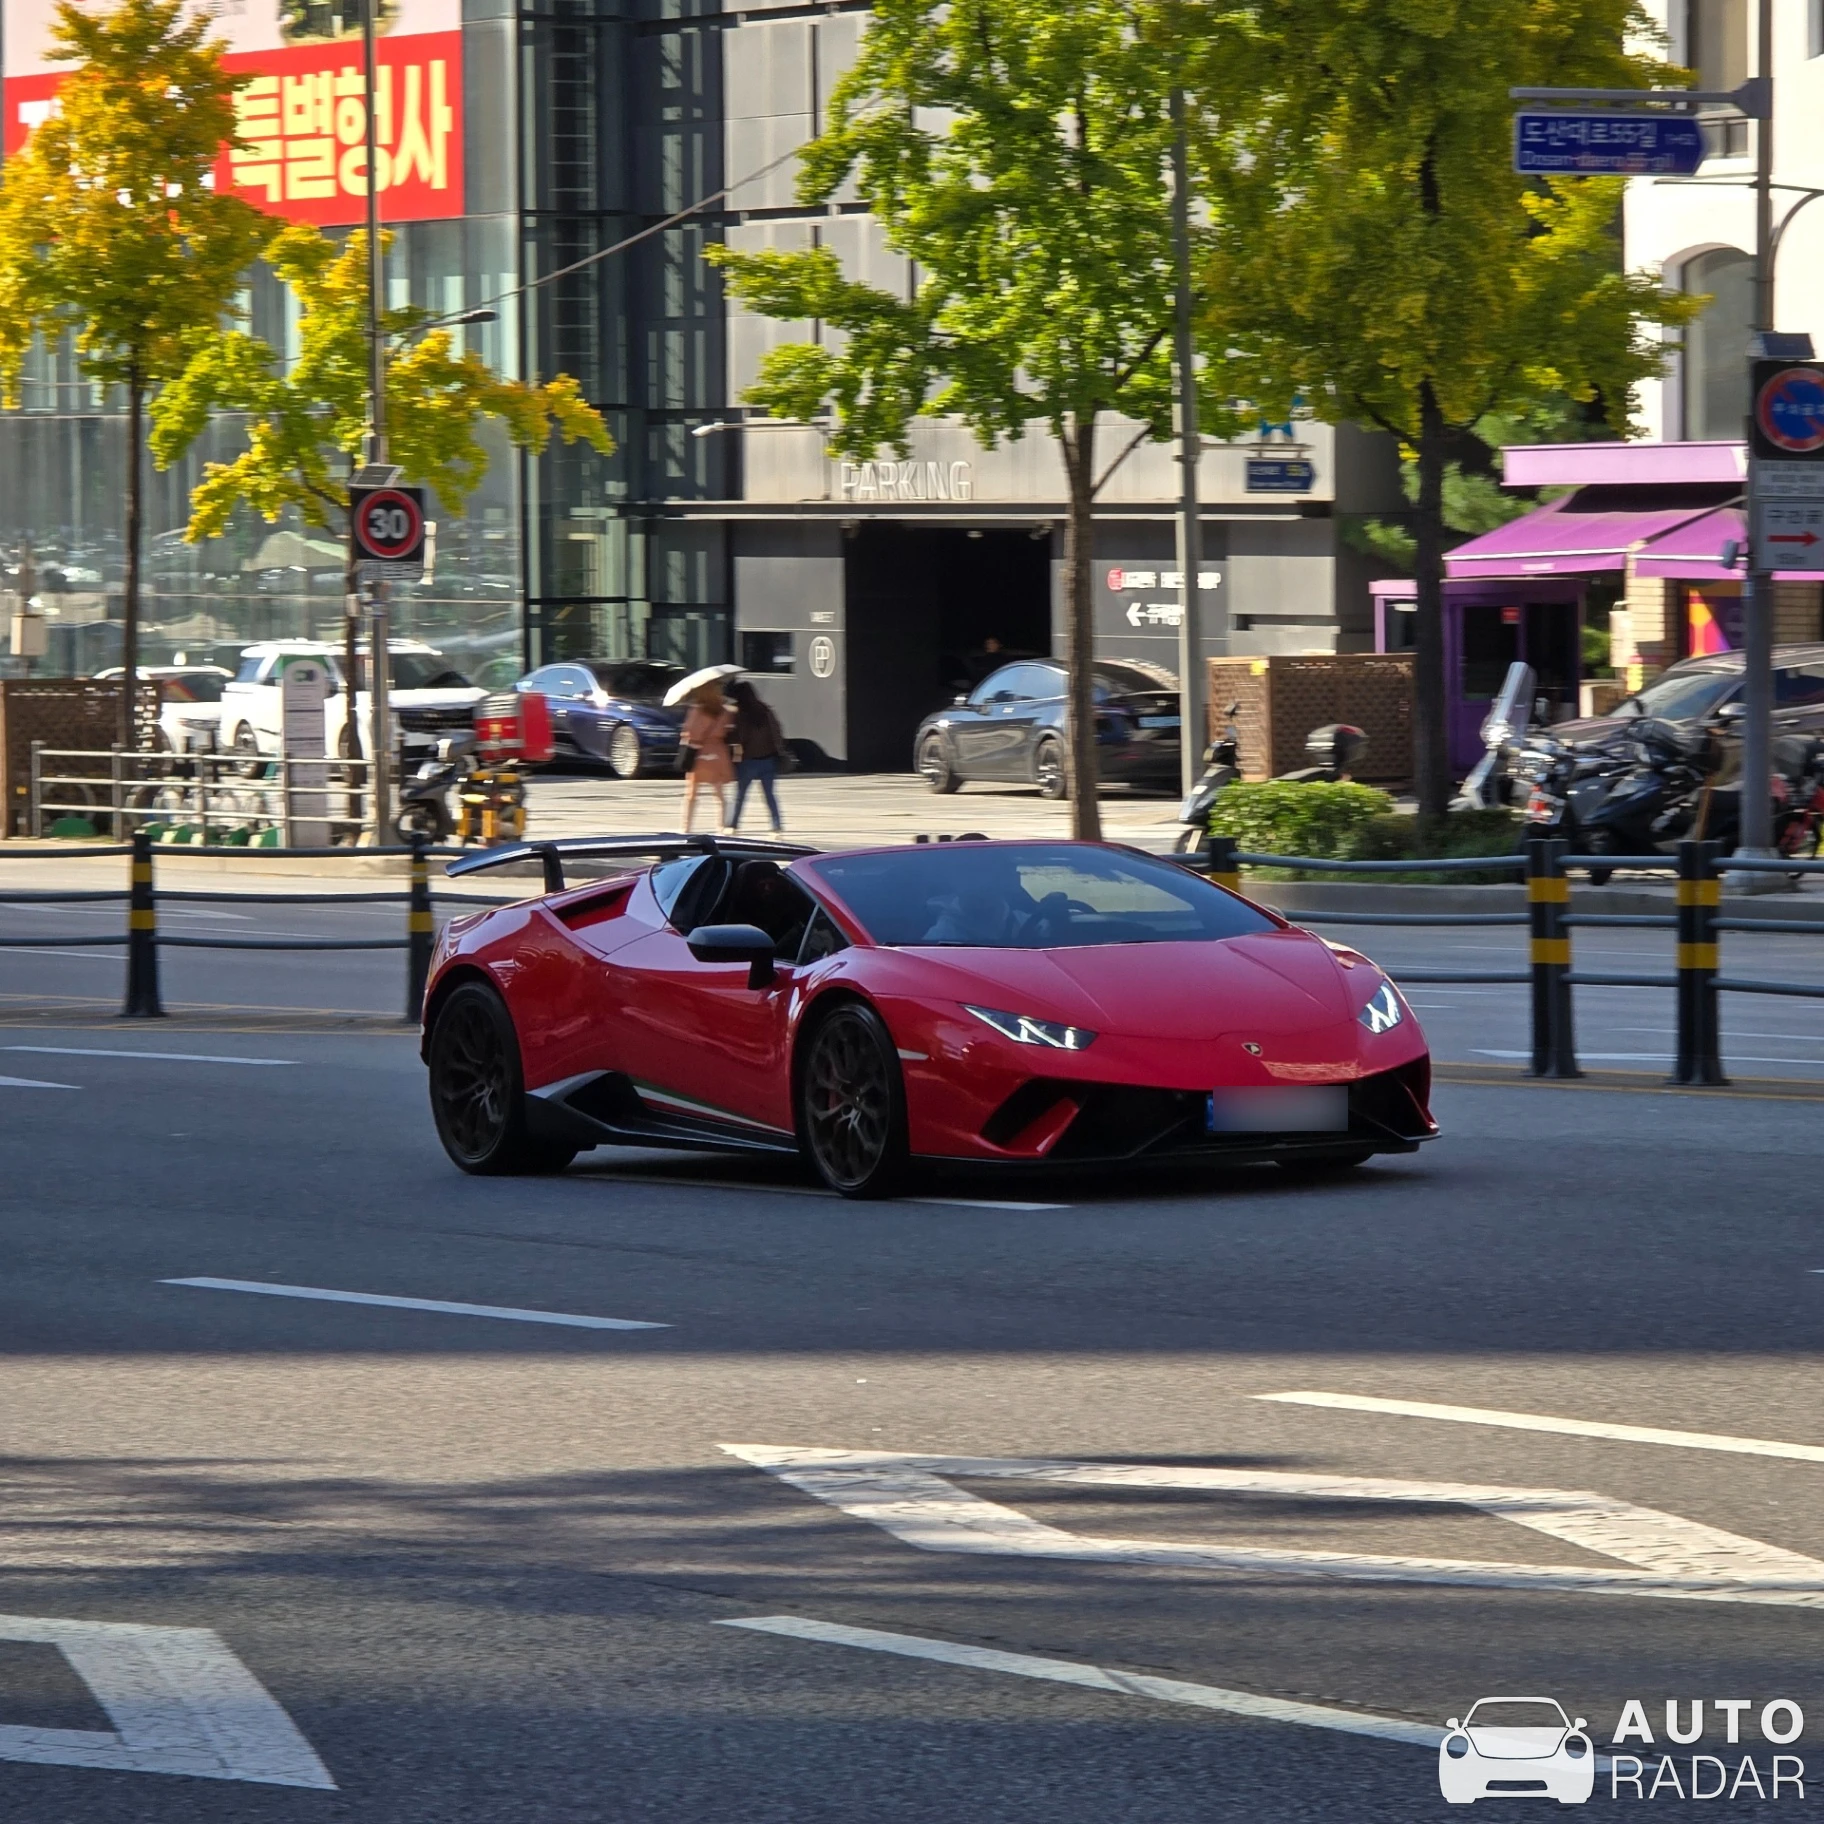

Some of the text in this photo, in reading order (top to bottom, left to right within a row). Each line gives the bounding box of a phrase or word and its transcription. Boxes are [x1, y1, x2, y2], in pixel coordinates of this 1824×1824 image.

[229, 60, 452, 203] 특별행사
[1523, 121, 1657, 148] 도산대로55길
[841, 461, 972, 500] PARKING
[368, 508, 410, 539] 30
